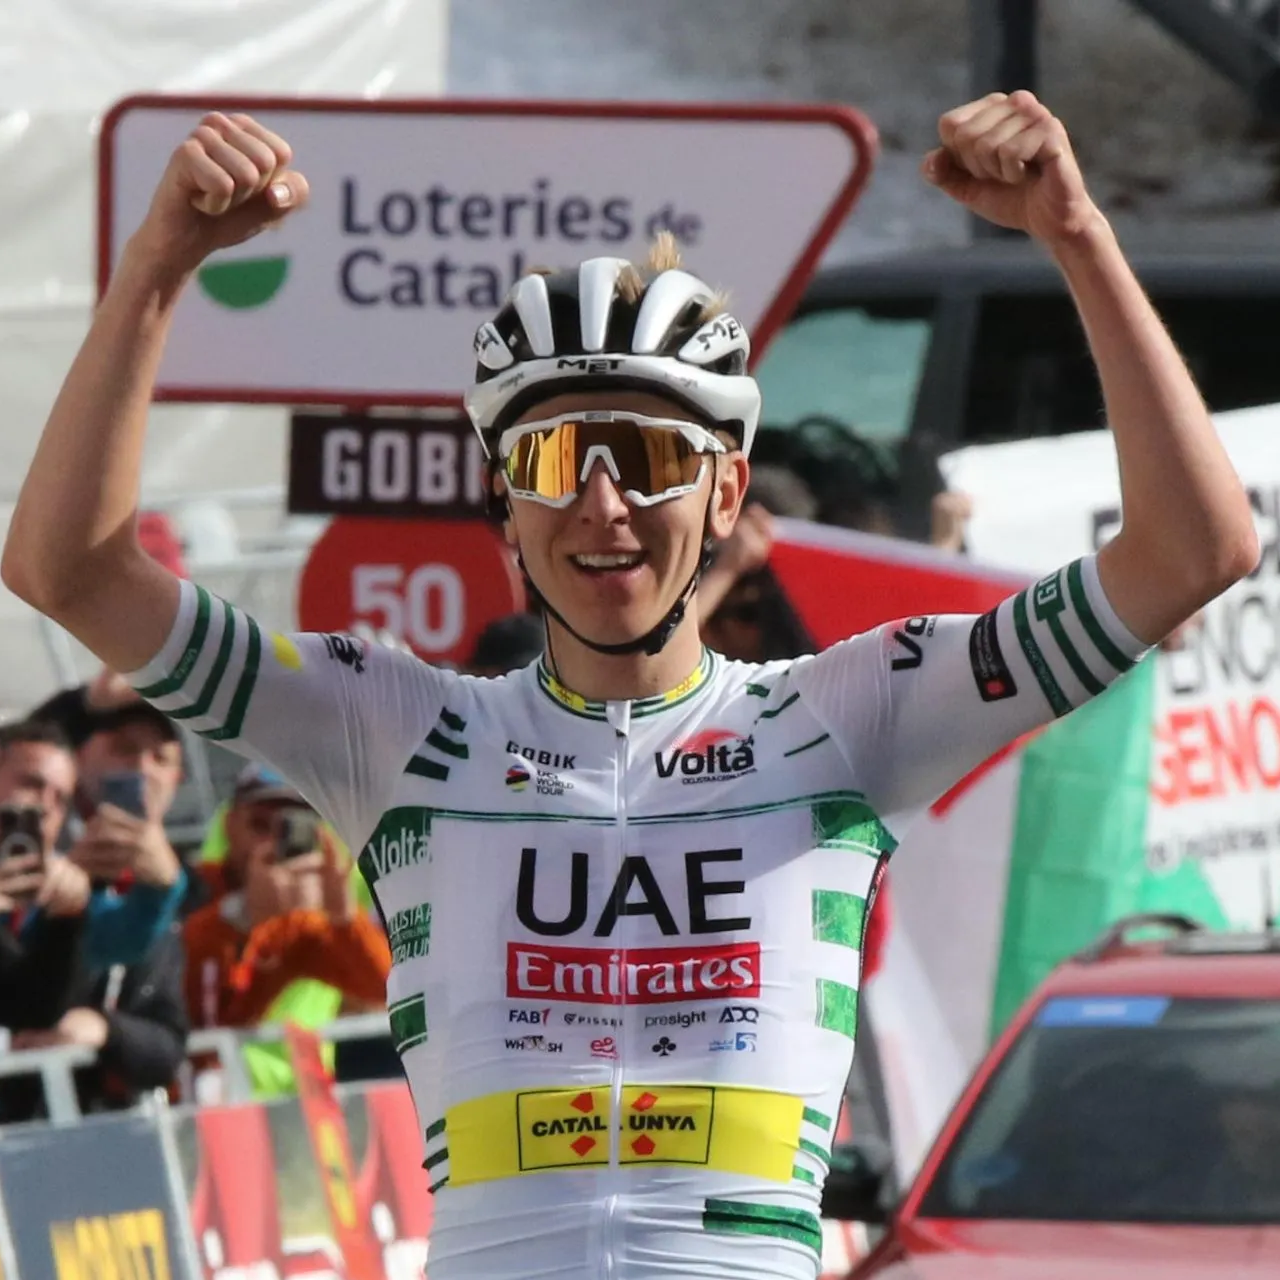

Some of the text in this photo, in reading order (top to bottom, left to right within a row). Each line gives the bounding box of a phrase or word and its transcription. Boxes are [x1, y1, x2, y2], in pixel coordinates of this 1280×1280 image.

[341, 176, 703, 246] Loteries de
[340, 248, 528, 309] Catal
[696, 316, 741, 351] ME
[557, 358, 626, 374] MET
[321, 427, 482, 504] GOBI
[352, 563, 465, 654] 50
[505, 740, 578, 769] GOBIK
[536, 786, 565, 797] TOUR
[515, 847, 753, 937] UAE
[515, 949, 754, 995] Emirates
[644, 1009, 707, 1029] presight
